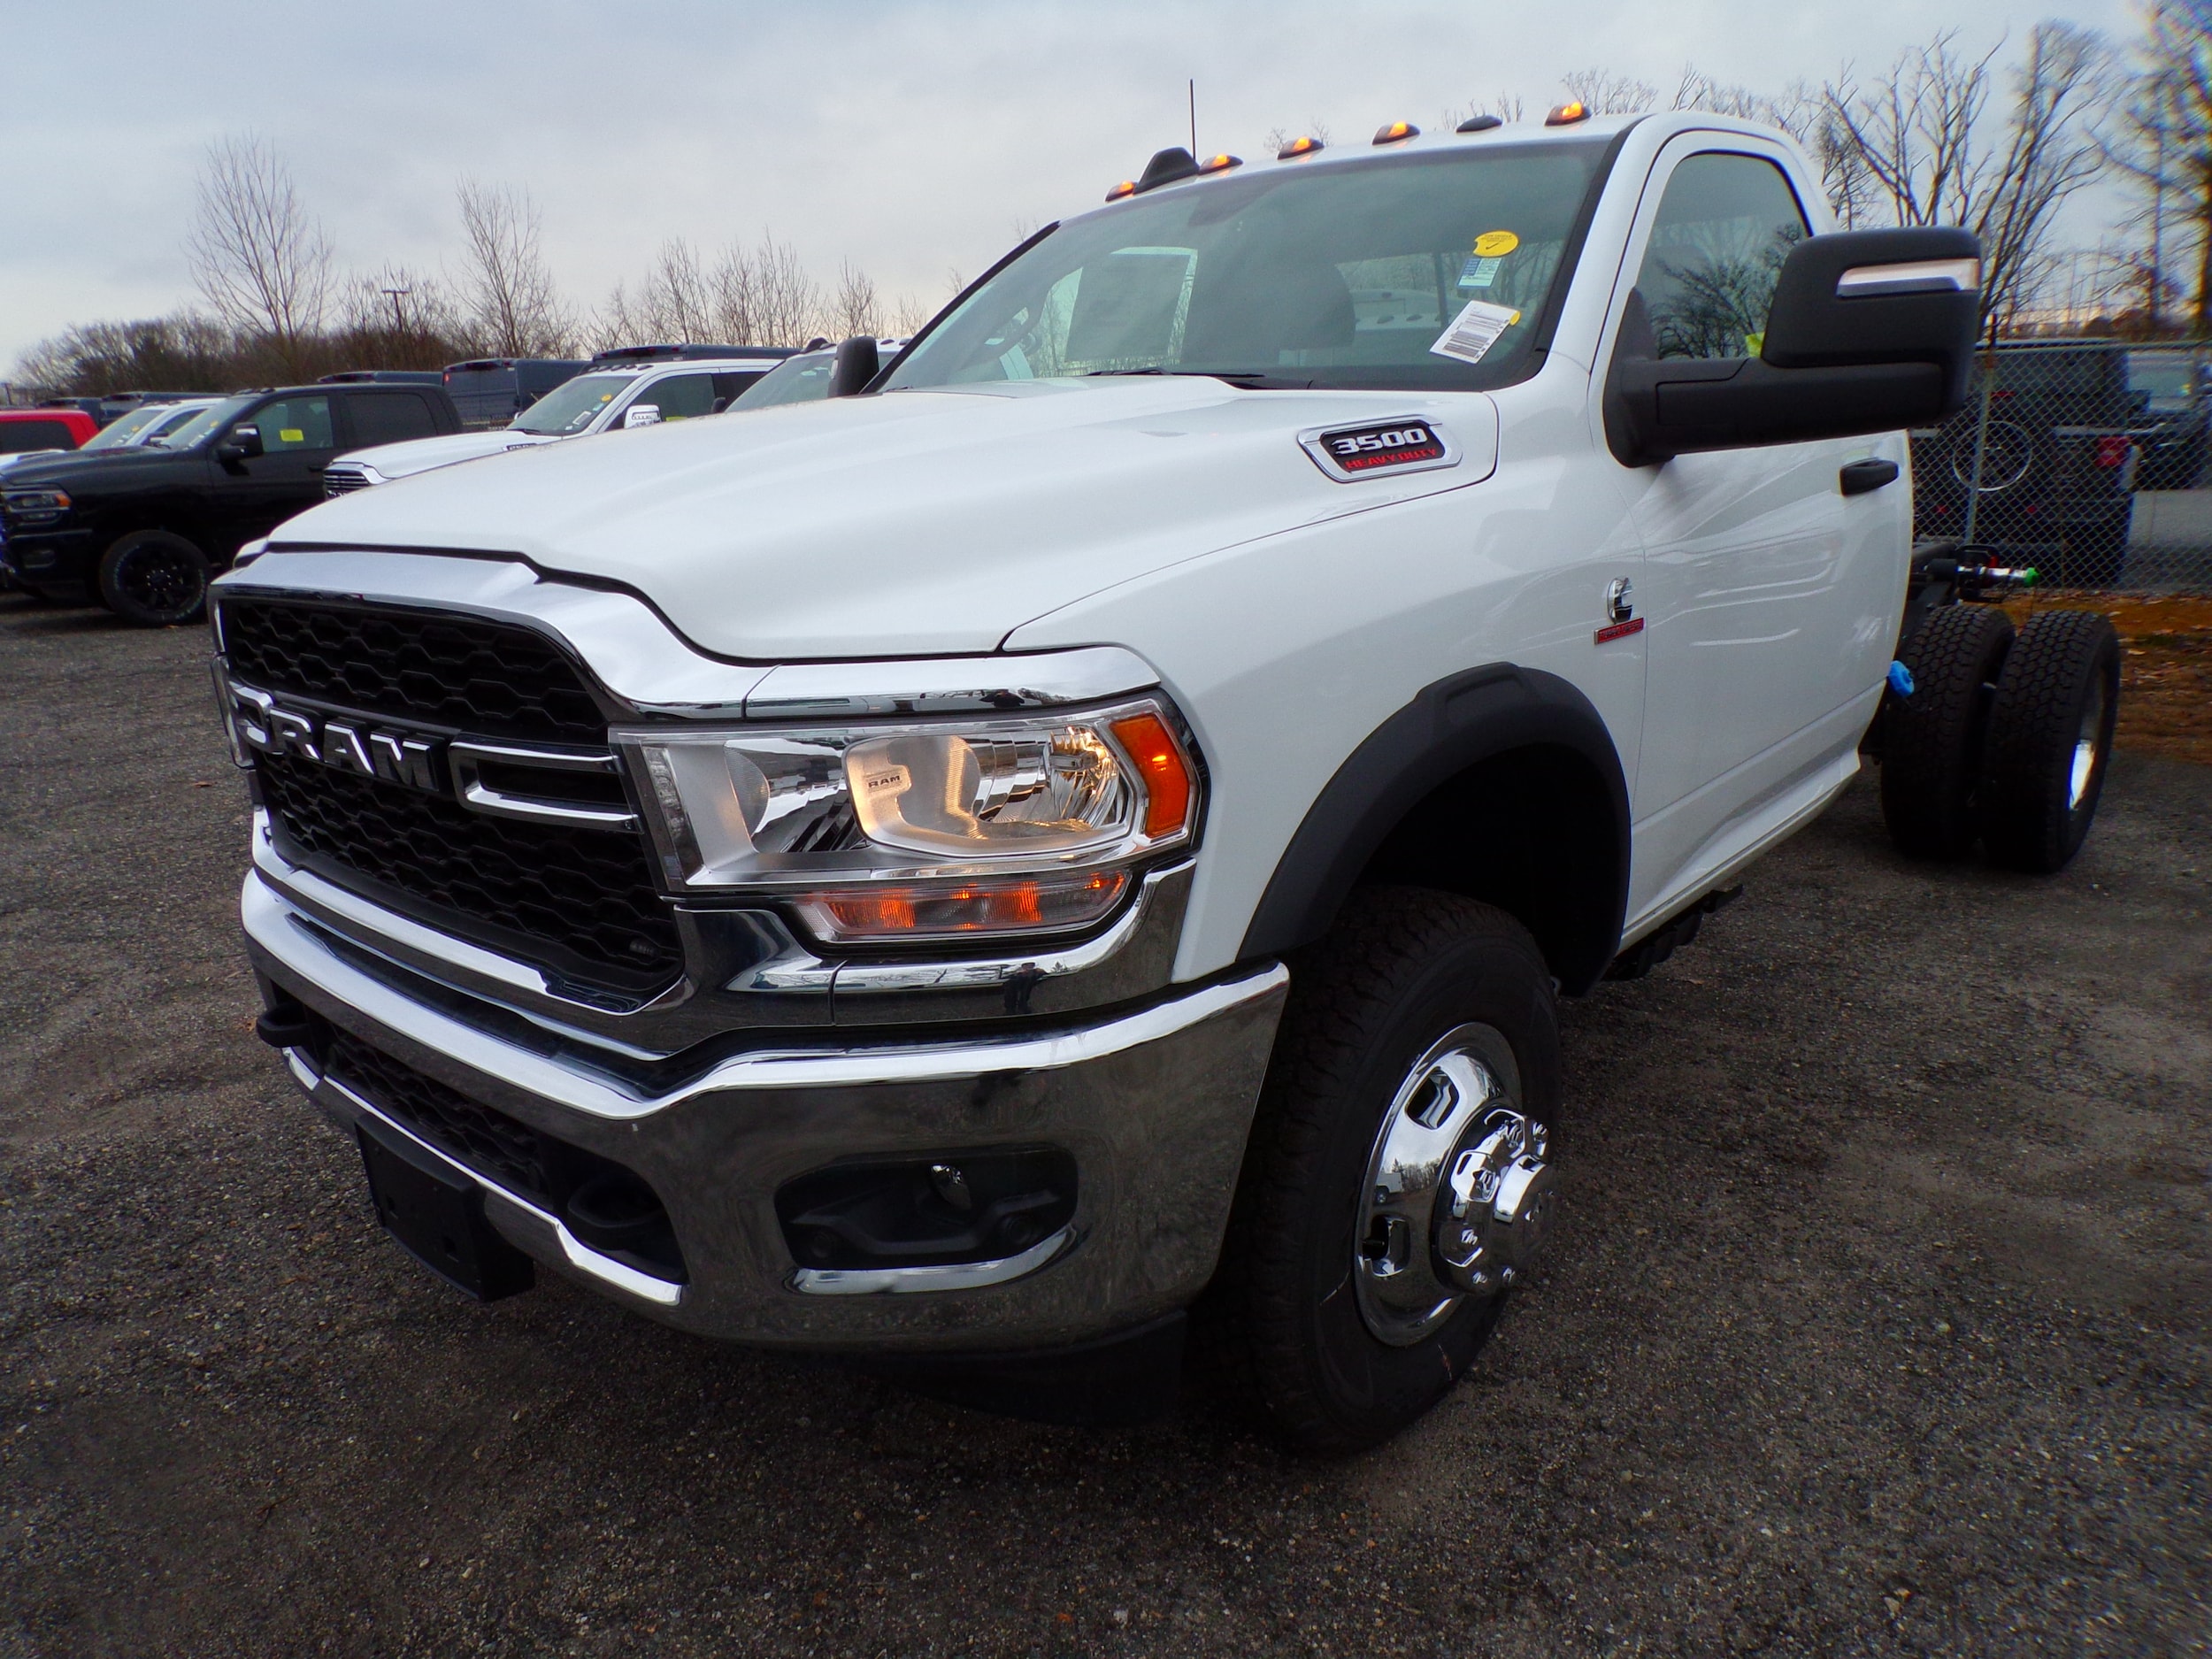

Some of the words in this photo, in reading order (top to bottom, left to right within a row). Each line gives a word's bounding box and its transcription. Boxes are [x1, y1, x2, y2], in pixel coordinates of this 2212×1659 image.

[1331, 428, 1428, 455] 3500
[1344, 454, 1396, 469] HEAVY
[1397, 449, 1437, 462] DUTY
[269, 707, 440, 792] RAM
[868, 775, 901, 788] RAM
